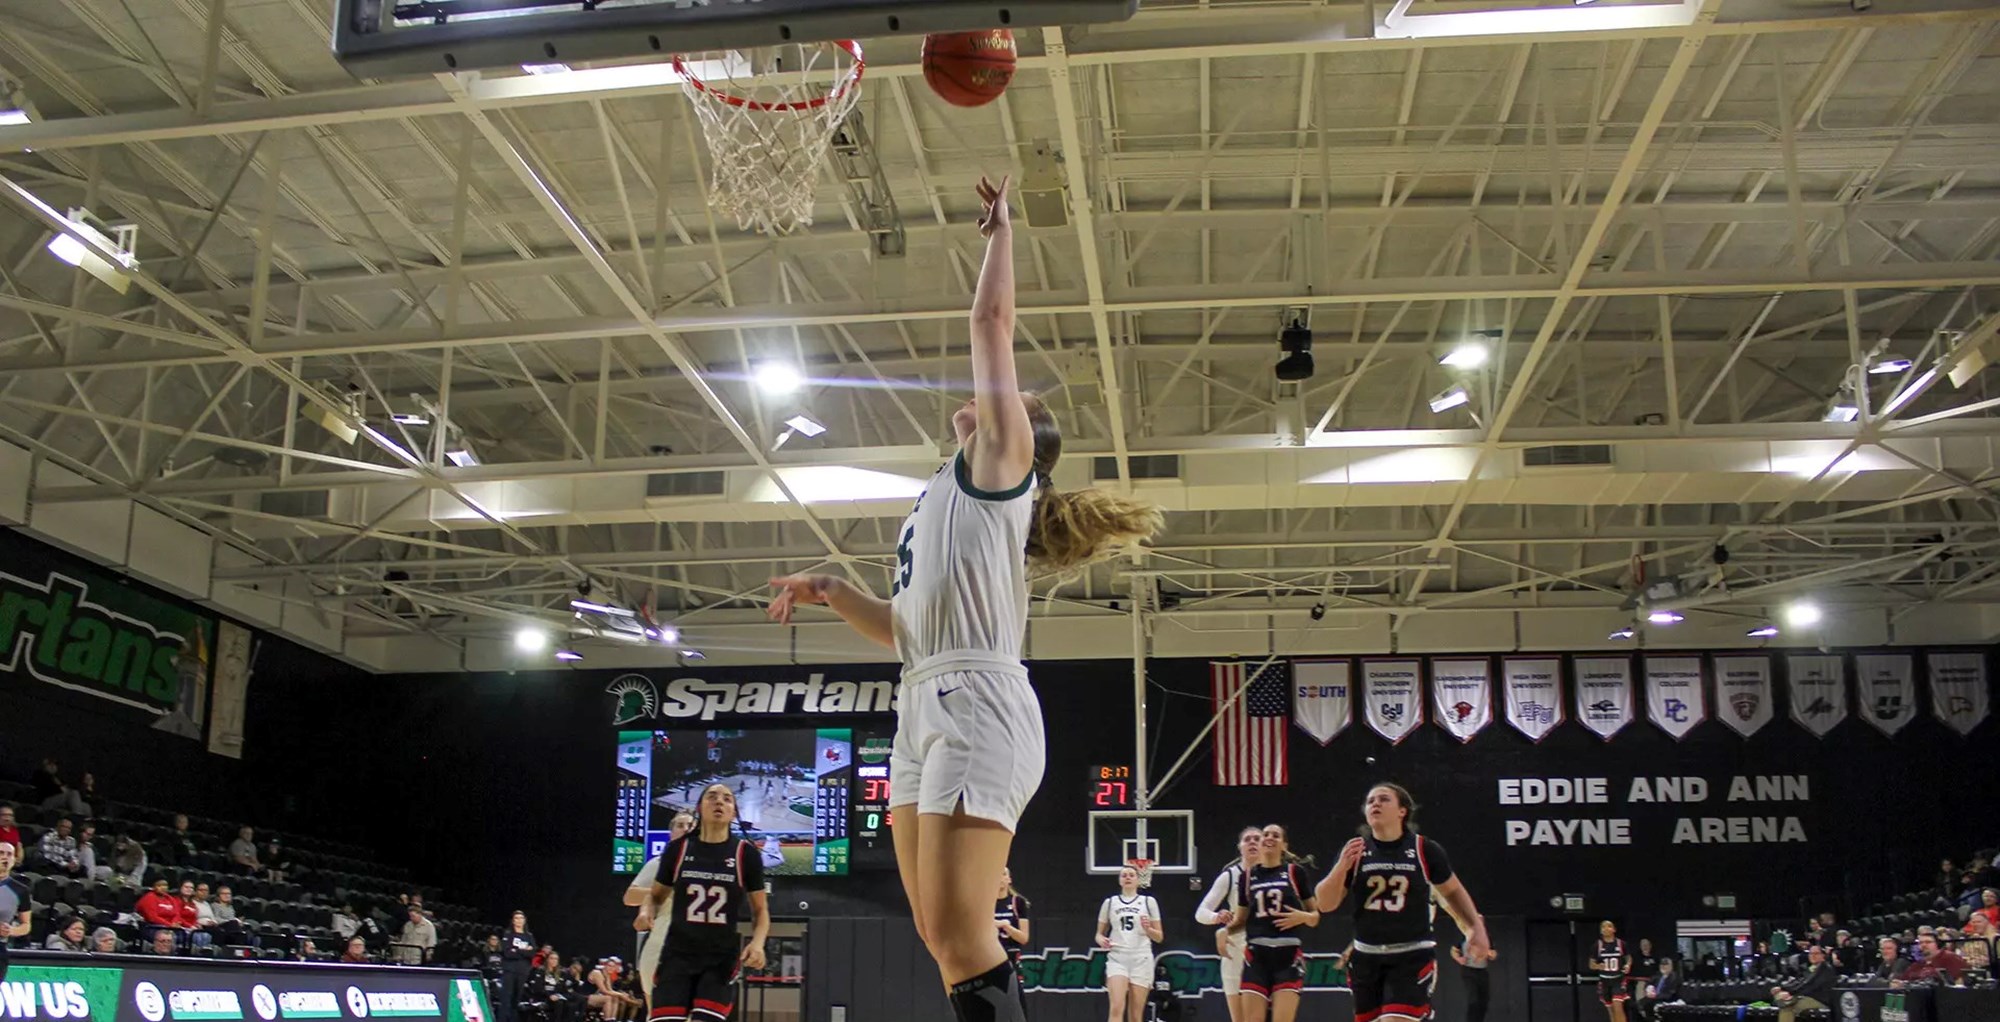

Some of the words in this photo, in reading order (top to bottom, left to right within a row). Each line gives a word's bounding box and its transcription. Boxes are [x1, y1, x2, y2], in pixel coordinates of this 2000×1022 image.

[1298, 685, 1347, 698] SOUTH
[1381, 703, 1404, 719] CSU
[1100, 766, 1129, 778] 8:17
[863, 780, 892, 801] 37
[1096, 782, 1127, 806] 27
[1498, 778, 1608, 805] EDDIE
[1627, 776, 1708, 803] AND
[1727, 775, 1809, 801] ANN
[867, 813, 880, 830] 0
[1506, 819, 1632, 846] PAYNE
[1672, 816, 1808, 843] ARENA
[686, 883, 728, 925] 22
[1254, 888, 1283, 918] 13
[1363, 874, 1410, 912] 23
[1120, 915, 1134, 931] 15
[1021, 950, 1108, 988] stat
[1604, 957, 1618, 972] 10
[0, 981, 38, 1019] W
[39, 981, 91, 1019] US
